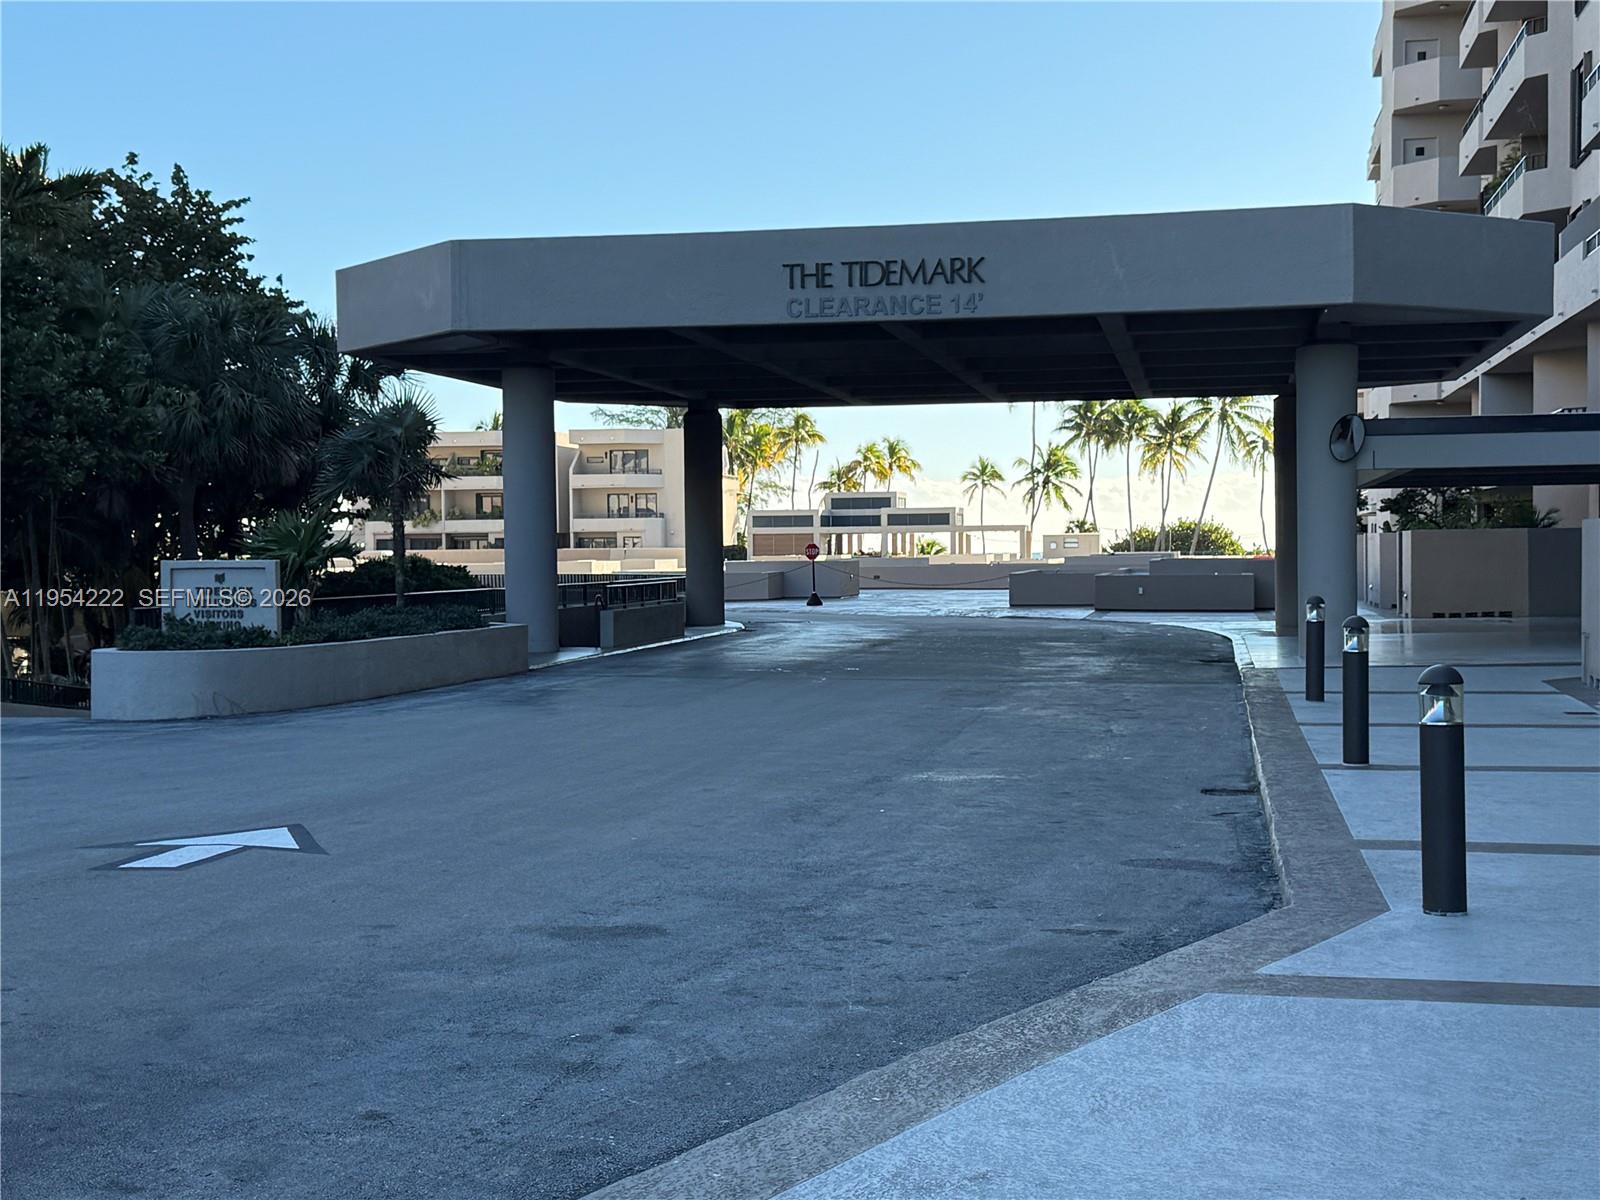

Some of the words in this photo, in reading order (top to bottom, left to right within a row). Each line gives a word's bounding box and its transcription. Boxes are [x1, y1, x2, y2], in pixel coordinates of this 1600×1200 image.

[782, 262, 834, 289] THE
[841, 256, 986, 288] TIDEMARK
[787, 294, 944, 319] CLEARANCE
[951, 292, 984, 314] 14'
[194, 609, 244, 619] VISITORS
